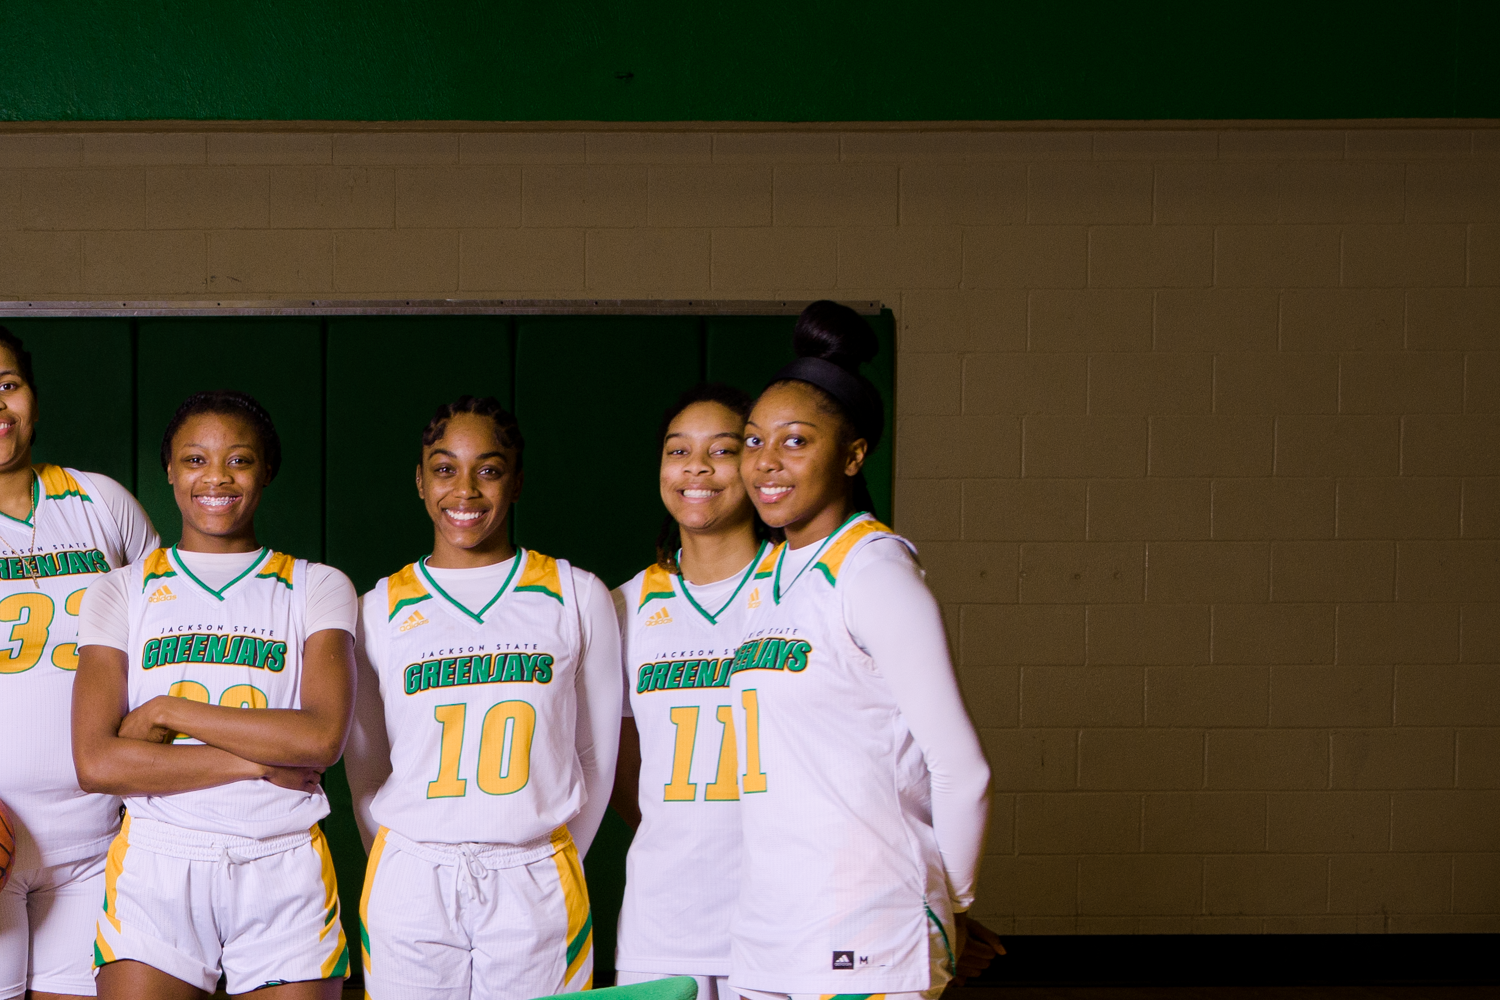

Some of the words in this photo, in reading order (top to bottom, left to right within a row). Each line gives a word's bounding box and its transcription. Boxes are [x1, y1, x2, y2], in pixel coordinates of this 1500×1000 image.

[53, 542, 88, 550] STATE
[148, 593, 177, 603] adidas
[161, 624, 224, 635] JACKSON
[234, 625, 275, 637] STATE
[400, 618, 430, 632] adidas
[142, 633, 288, 673] GREENJAYS
[421, 644, 485, 659] JACKSON
[655, 649, 715, 660] JACKSON
[403, 652, 555, 697] GREENJAYS
[426, 699, 537, 799] 10
